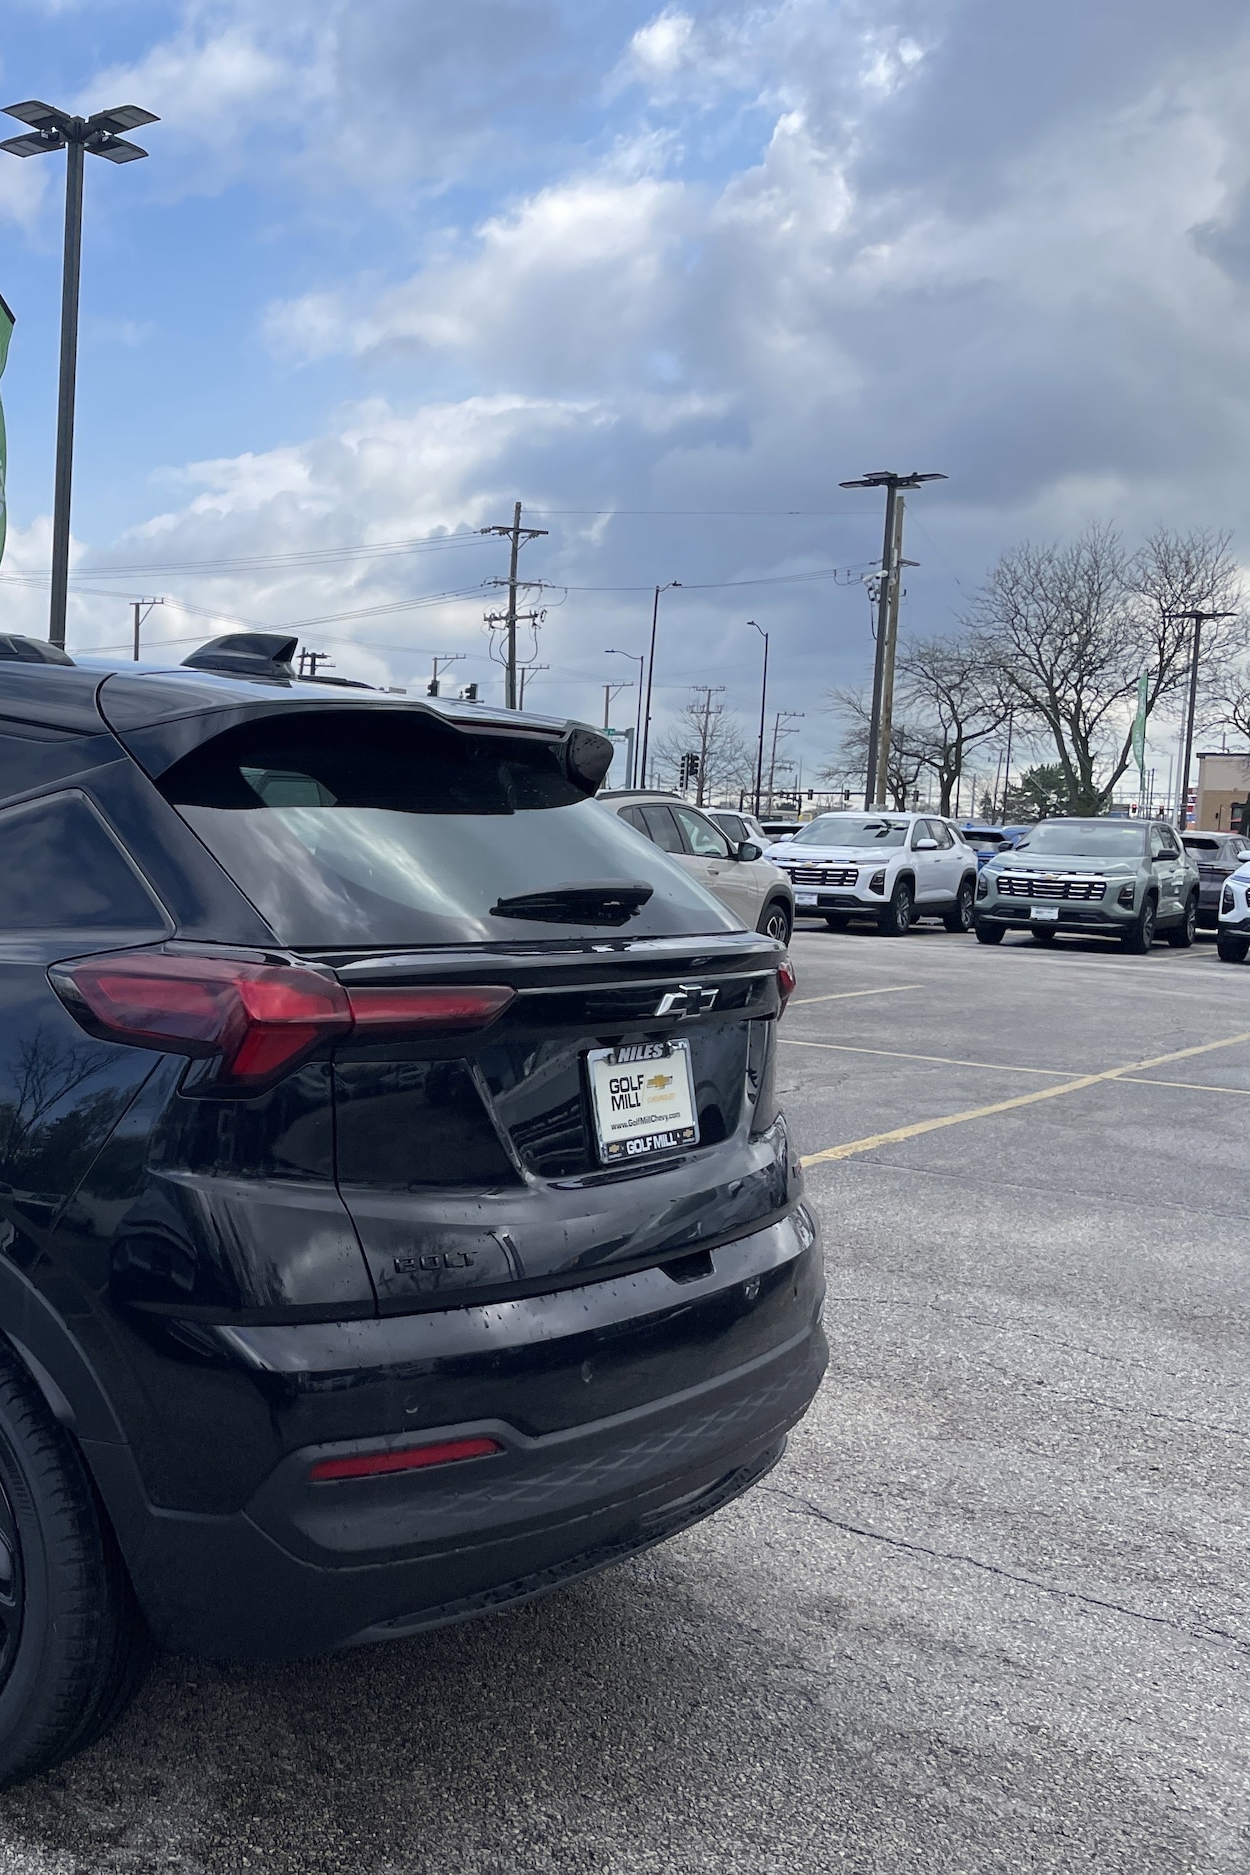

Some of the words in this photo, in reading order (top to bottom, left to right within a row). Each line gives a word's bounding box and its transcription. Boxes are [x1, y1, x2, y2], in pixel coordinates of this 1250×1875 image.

[618, 1043, 664, 1062] NILES
[609, 1074, 645, 1094] GOLF
[611, 1092, 642, 1112] MILL
[610, 1112, 681, 1131] www.GolfMillChevy.com
[626, 1136, 653, 1155] GOLF
[653, 1132, 678, 1150] MILL
[393, 1251, 478, 1273] BOLT
